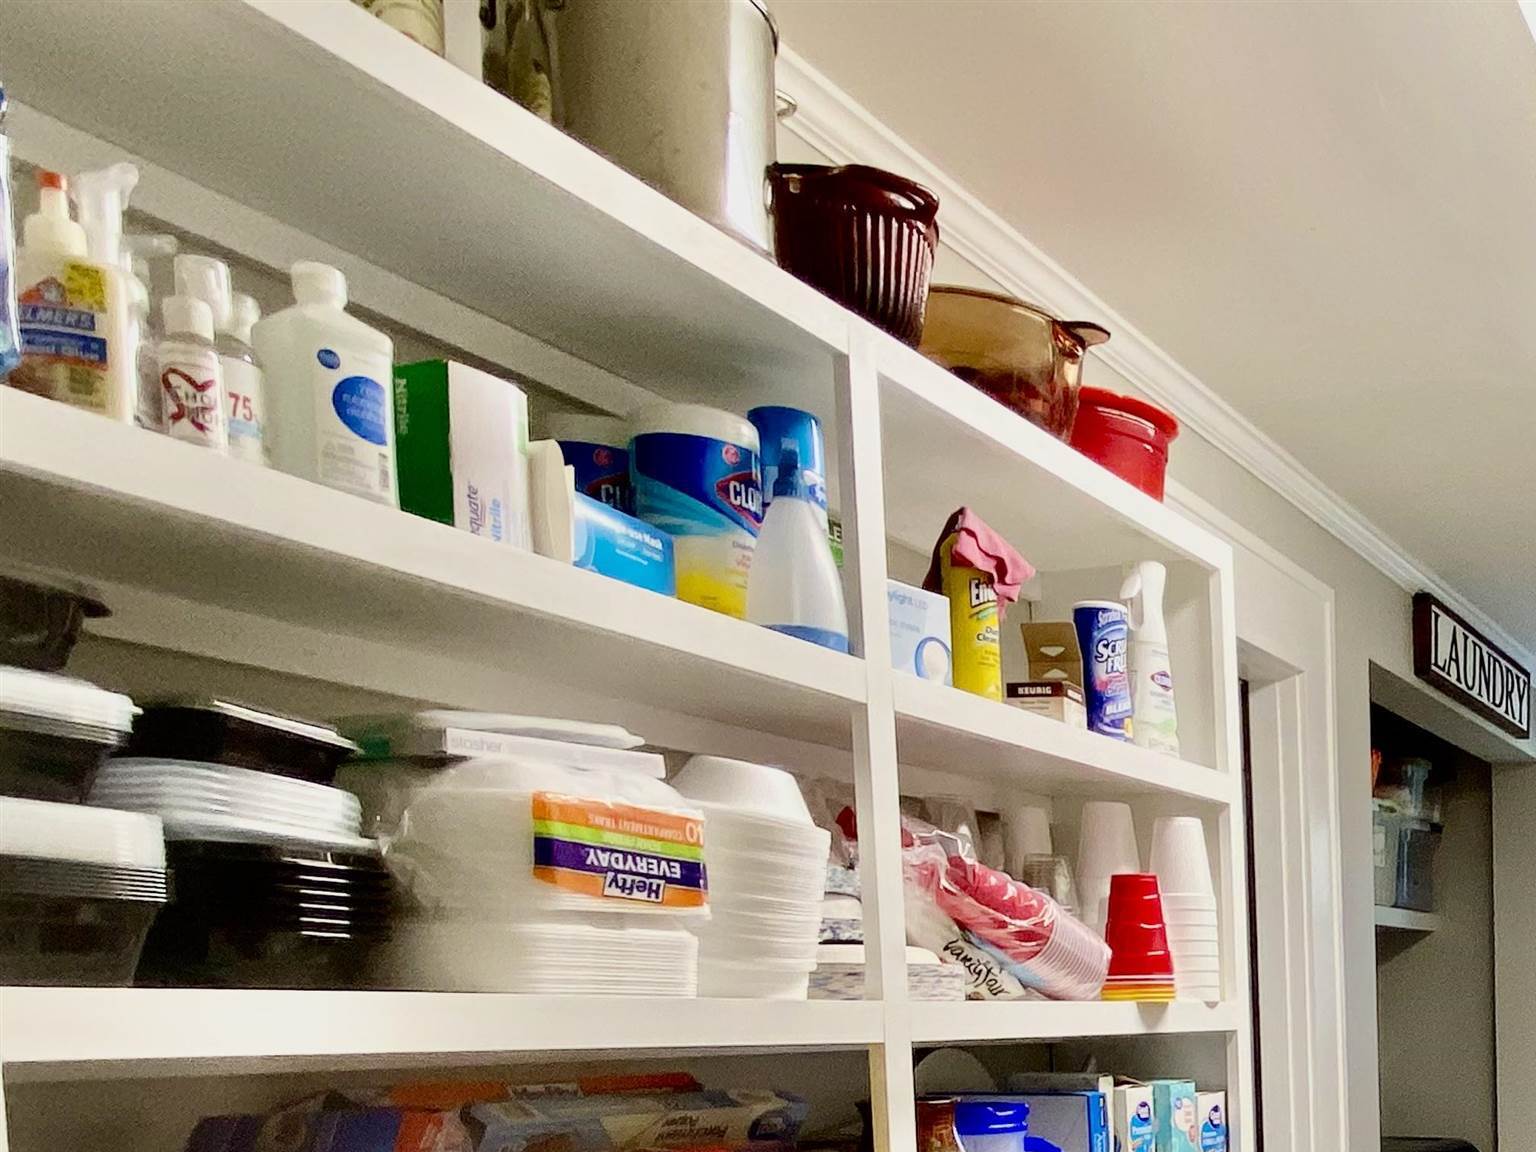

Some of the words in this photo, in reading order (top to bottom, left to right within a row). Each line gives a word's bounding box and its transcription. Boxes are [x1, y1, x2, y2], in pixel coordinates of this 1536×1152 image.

[1432, 610, 1528, 726] LAUNDRY
[1017, 686, 1052, 696] KEURIG
[585, 850, 681, 879] EVERYDAY
[608, 872, 661, 900] Hefty
